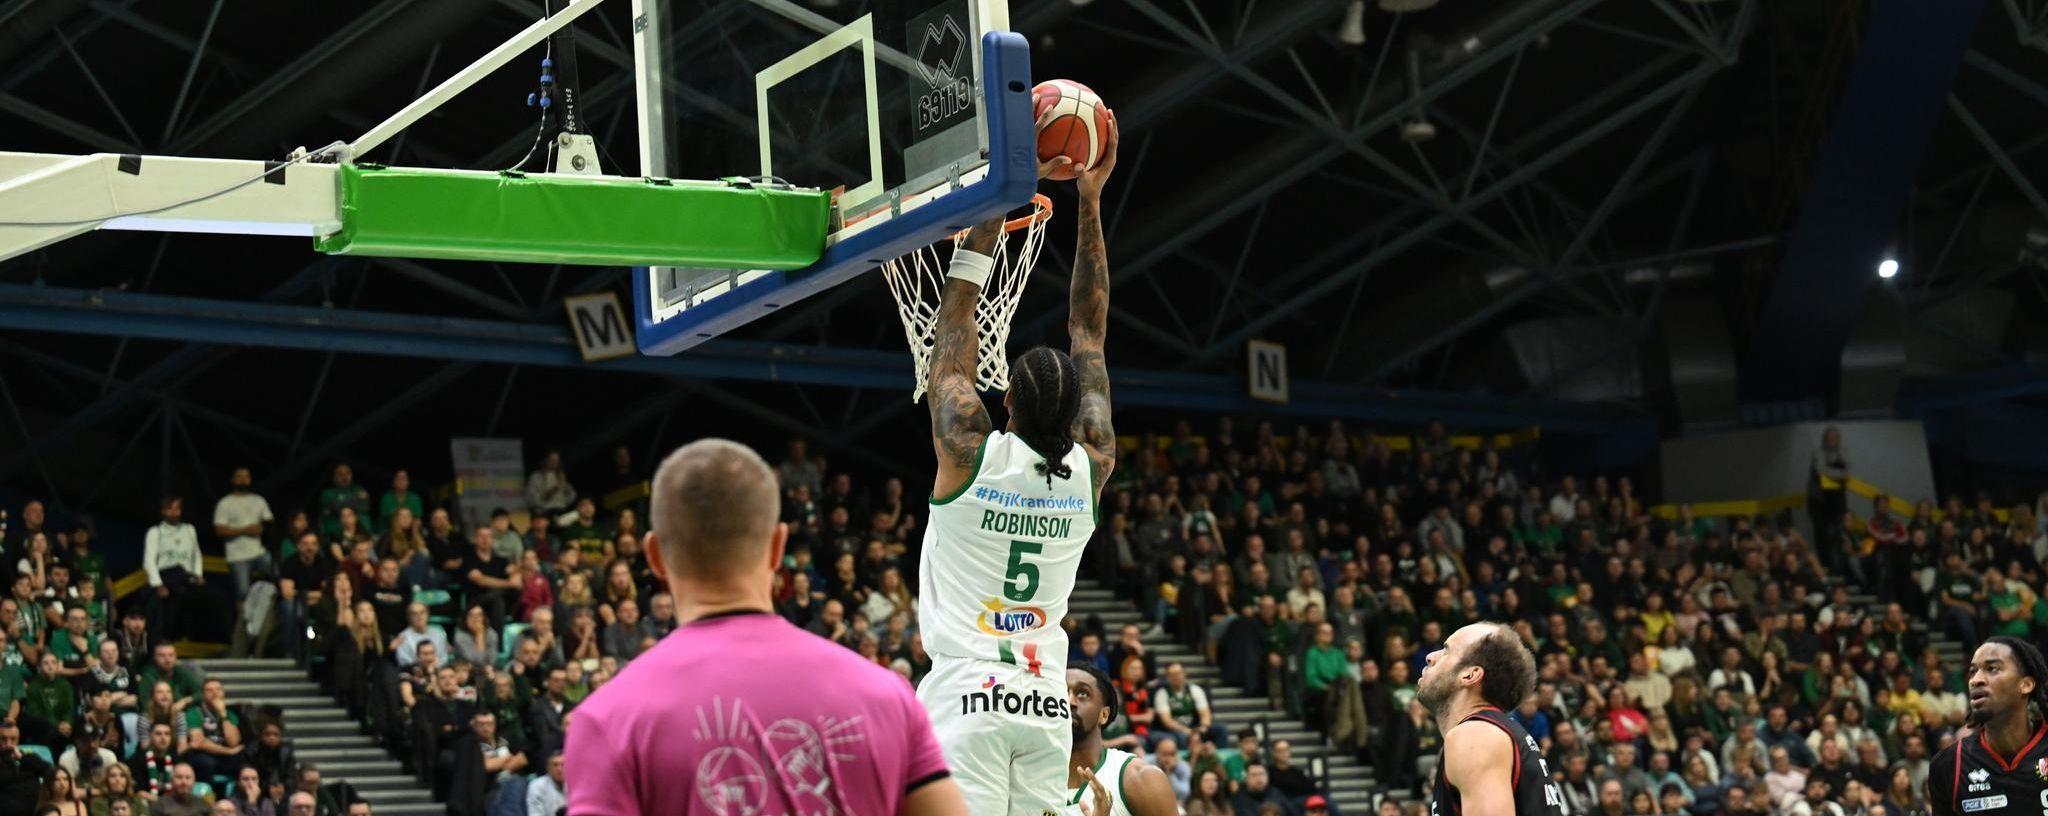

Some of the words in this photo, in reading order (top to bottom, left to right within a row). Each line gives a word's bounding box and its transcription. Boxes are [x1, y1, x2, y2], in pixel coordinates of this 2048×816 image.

[576, 303, 626, 348] M
[1257, 350, 1280, 391] N
[975, 486, 1086, 512] #PijKranówkę
[980, 509, 1073, 538] ROBINSON
[1003, 539, 1043, 602] 5
[994, 611, 1035, 632] LOTTO
[962, 683, 1069, 720] infortes
